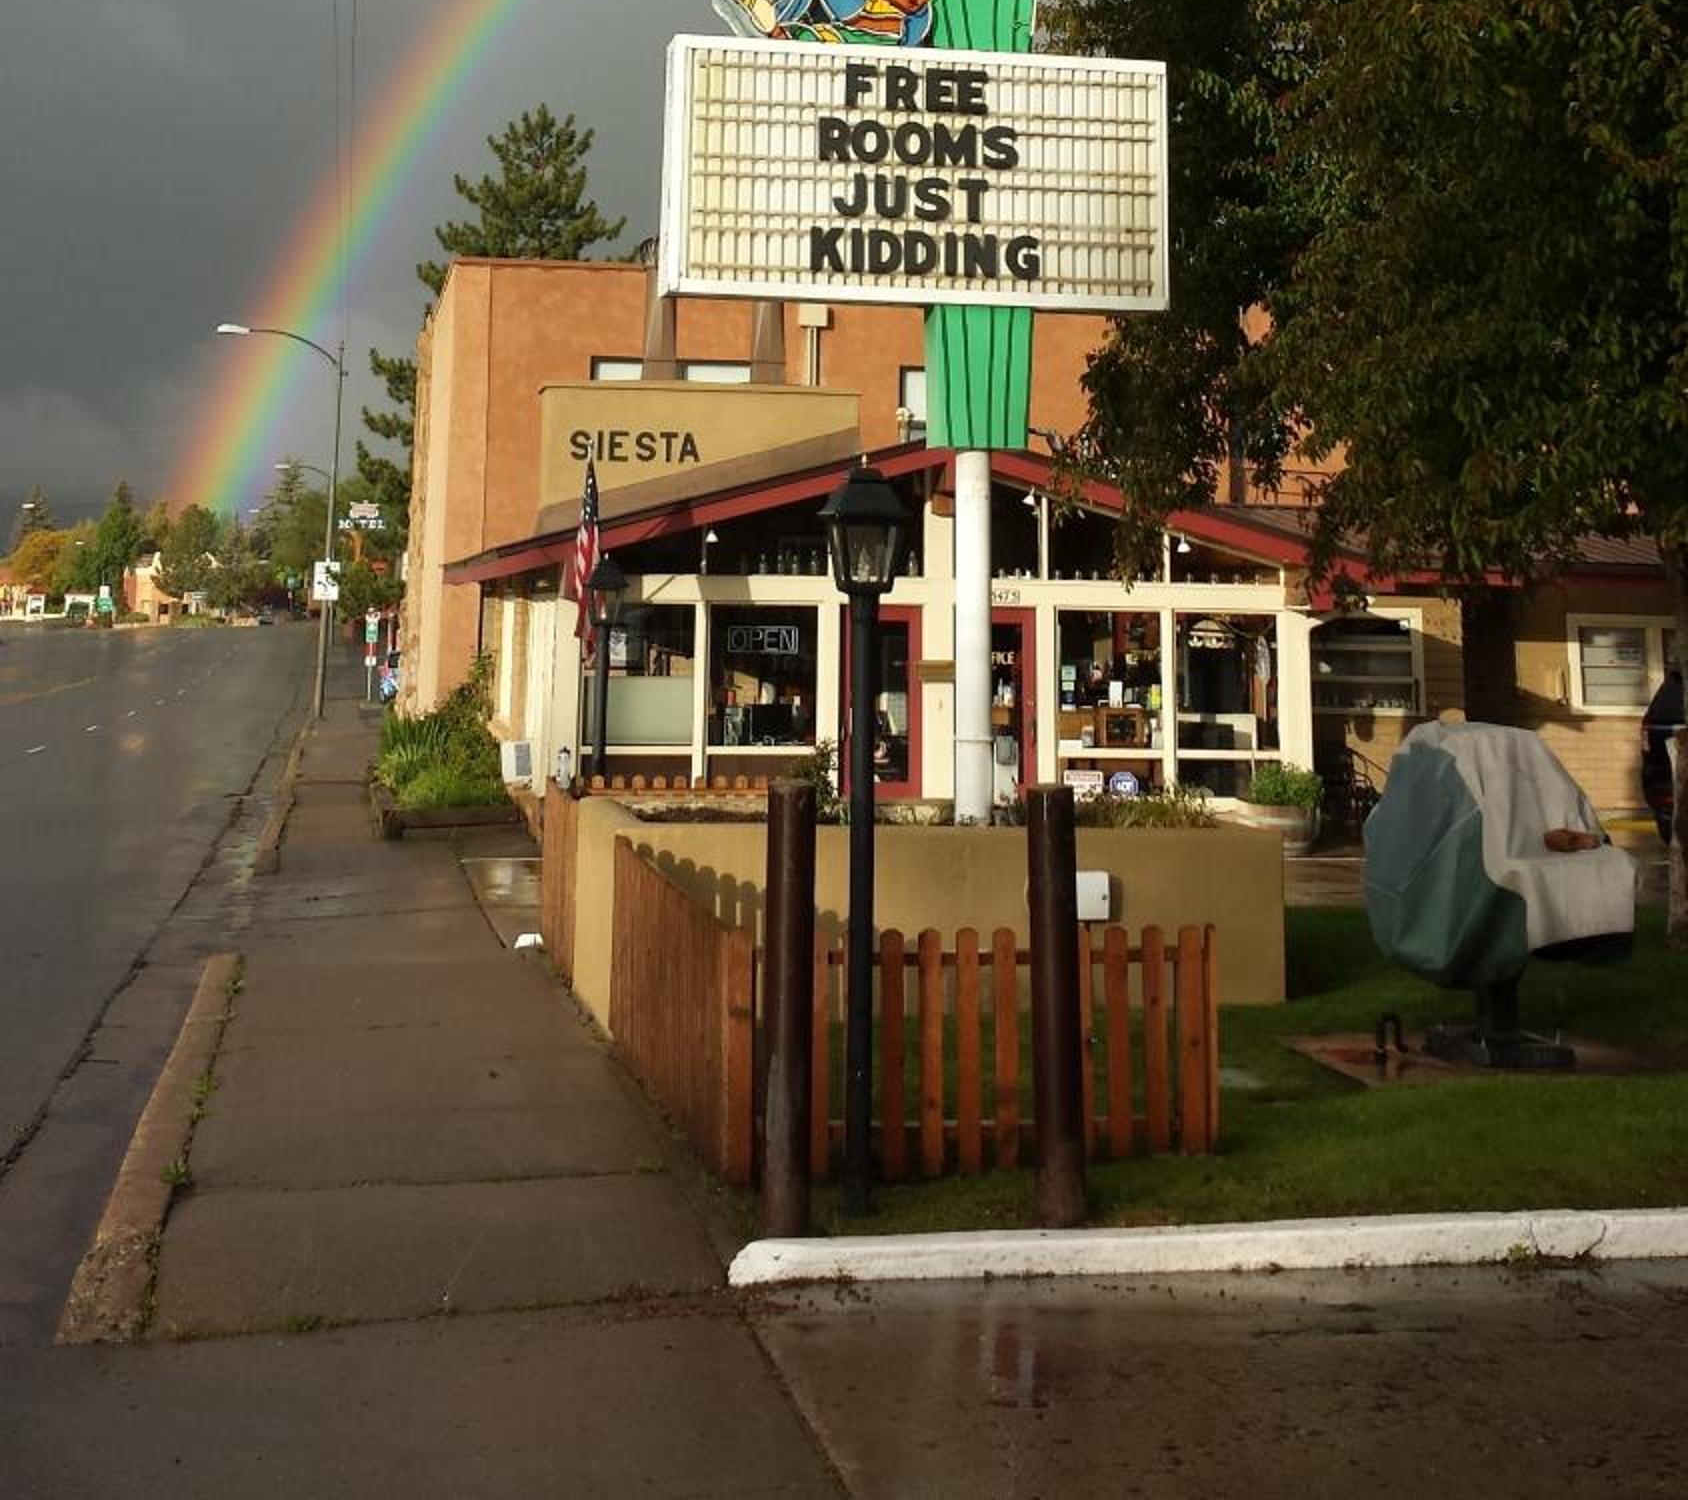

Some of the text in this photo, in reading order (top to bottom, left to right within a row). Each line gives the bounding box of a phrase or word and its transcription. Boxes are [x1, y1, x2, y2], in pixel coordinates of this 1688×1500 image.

[846, 63, 988, 115] FREE
[818, 116, 1019, 170] ROOMS
[832, 173, 989, 224] JUST
[809, 225, 1041, 281] KIDDING
[569, 430, 700, 463] SIESTA
[731, 629, 796, 651] OPEN
[992, 651, 1015, 665] FICE
